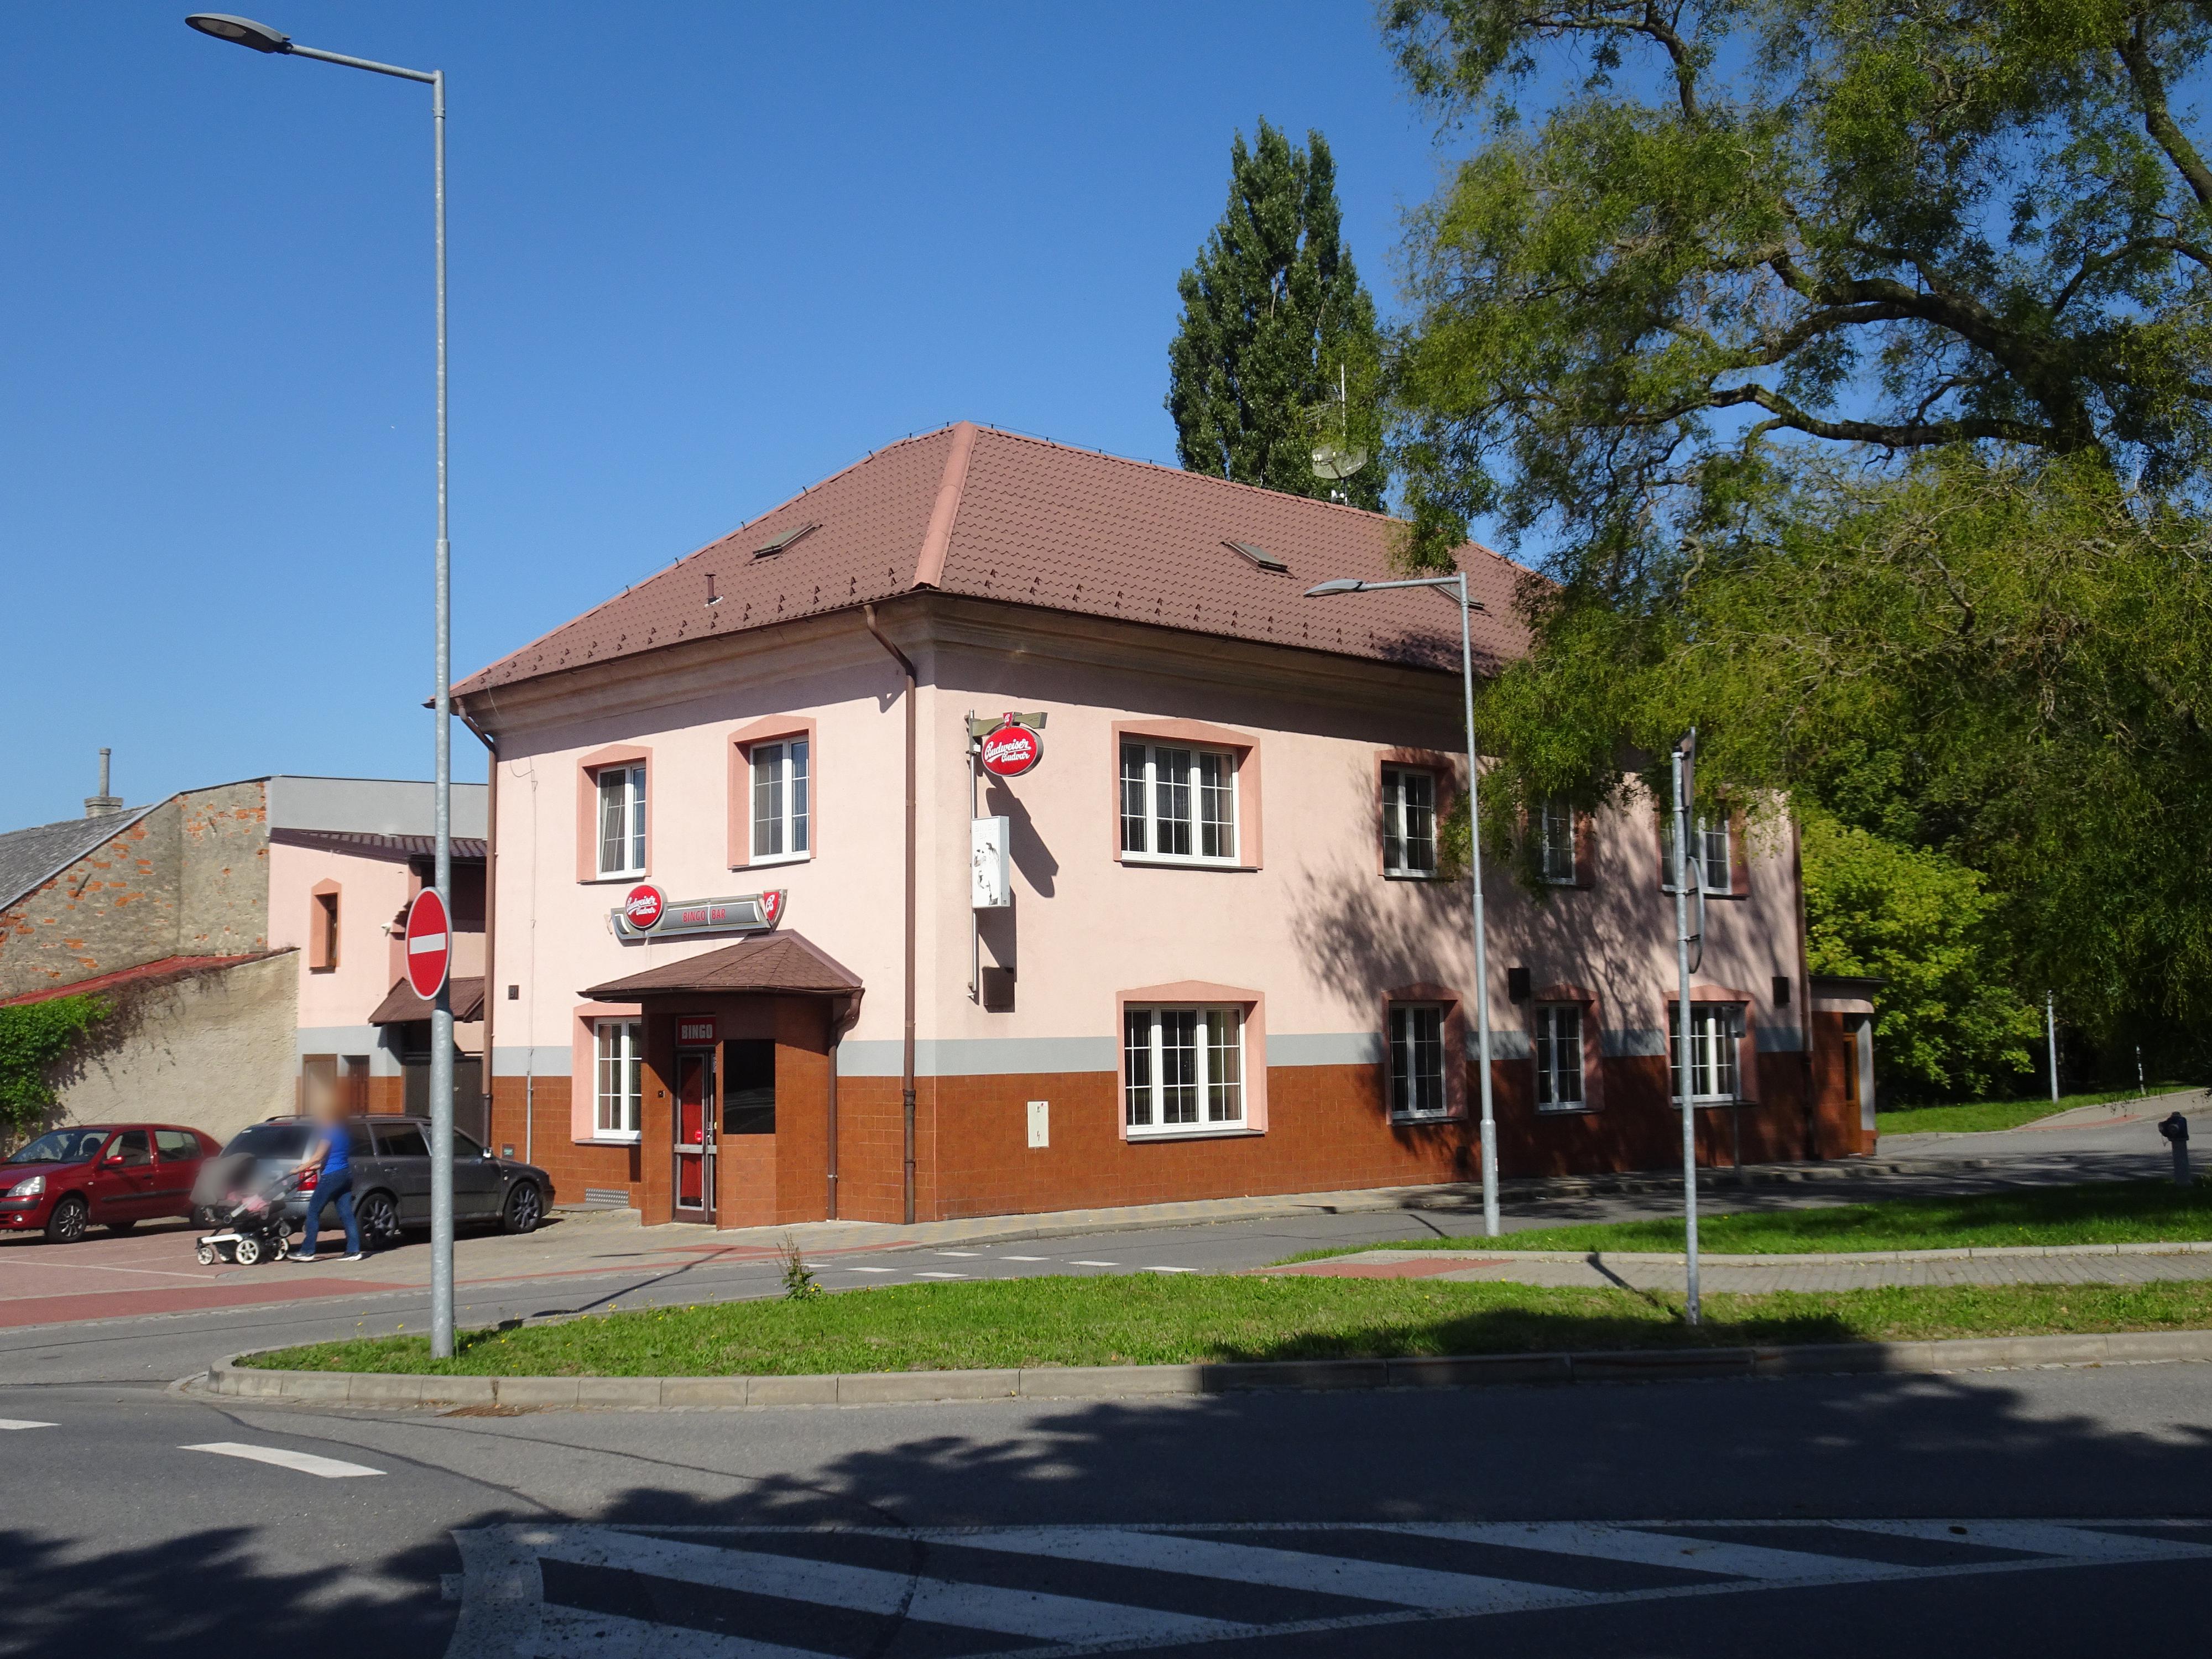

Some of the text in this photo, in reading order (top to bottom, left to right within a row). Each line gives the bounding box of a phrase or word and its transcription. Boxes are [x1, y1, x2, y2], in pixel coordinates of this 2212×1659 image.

[984, 738, 1031, 762] Budweiser
[1001, 752, 1030, 763] Budvar
[683, 909, 726, 922] BINGO BAR
[681, 1024, 713, 1039] BINGO
